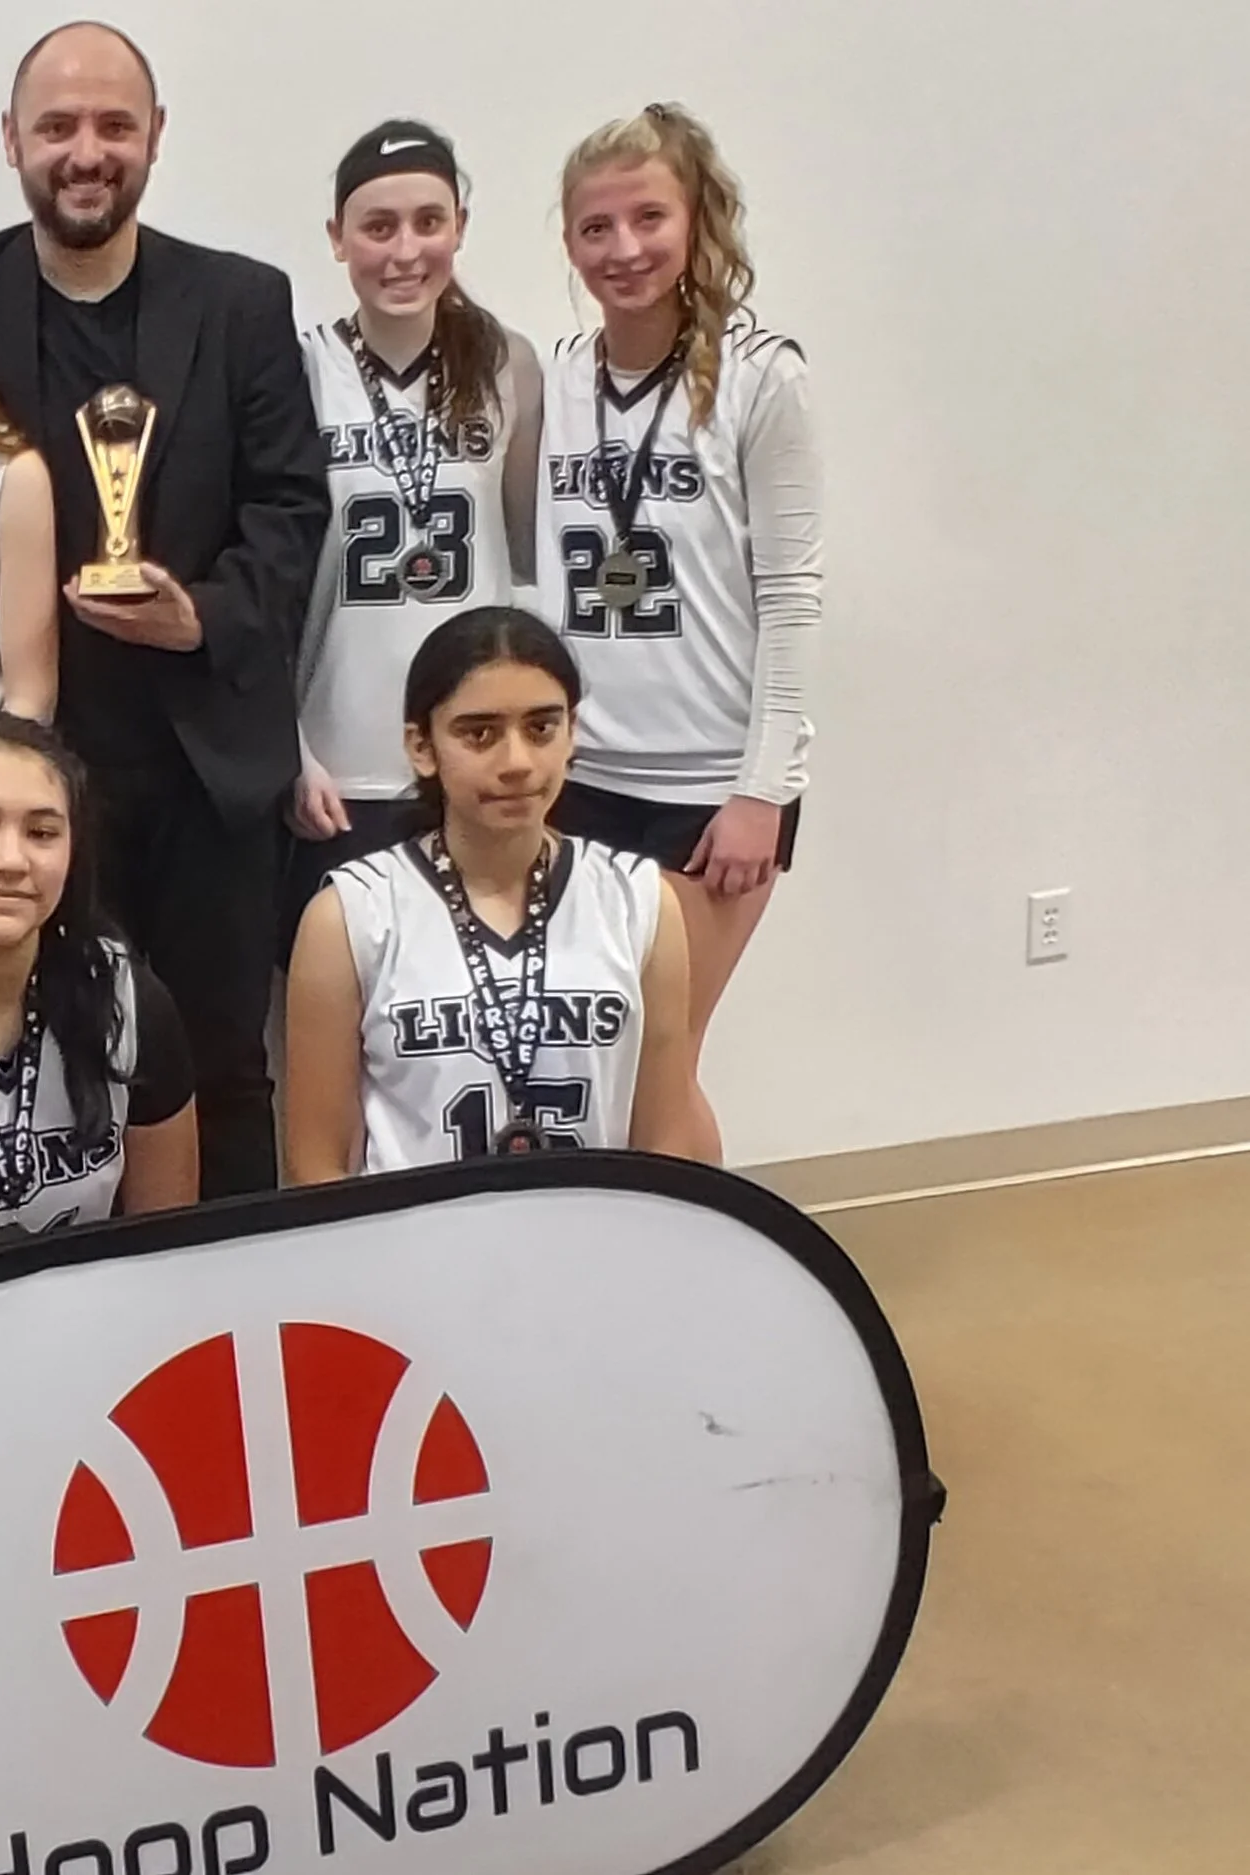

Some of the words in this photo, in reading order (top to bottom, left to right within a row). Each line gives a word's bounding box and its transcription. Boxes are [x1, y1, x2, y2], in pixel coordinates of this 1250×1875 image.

[383, 423, 416, 505] FIRST
[421, 417, 438, 502] PLACE
[341, 489, 475, 606] 23
[561, 524, 682, 638] 22
[473, 966, 512, 1069] FIRST
[518, 957, 543, 1063] PLACE
[14, 1066, 35, 1173] PLACE
[314, 1711, 700, 1856] Nation
